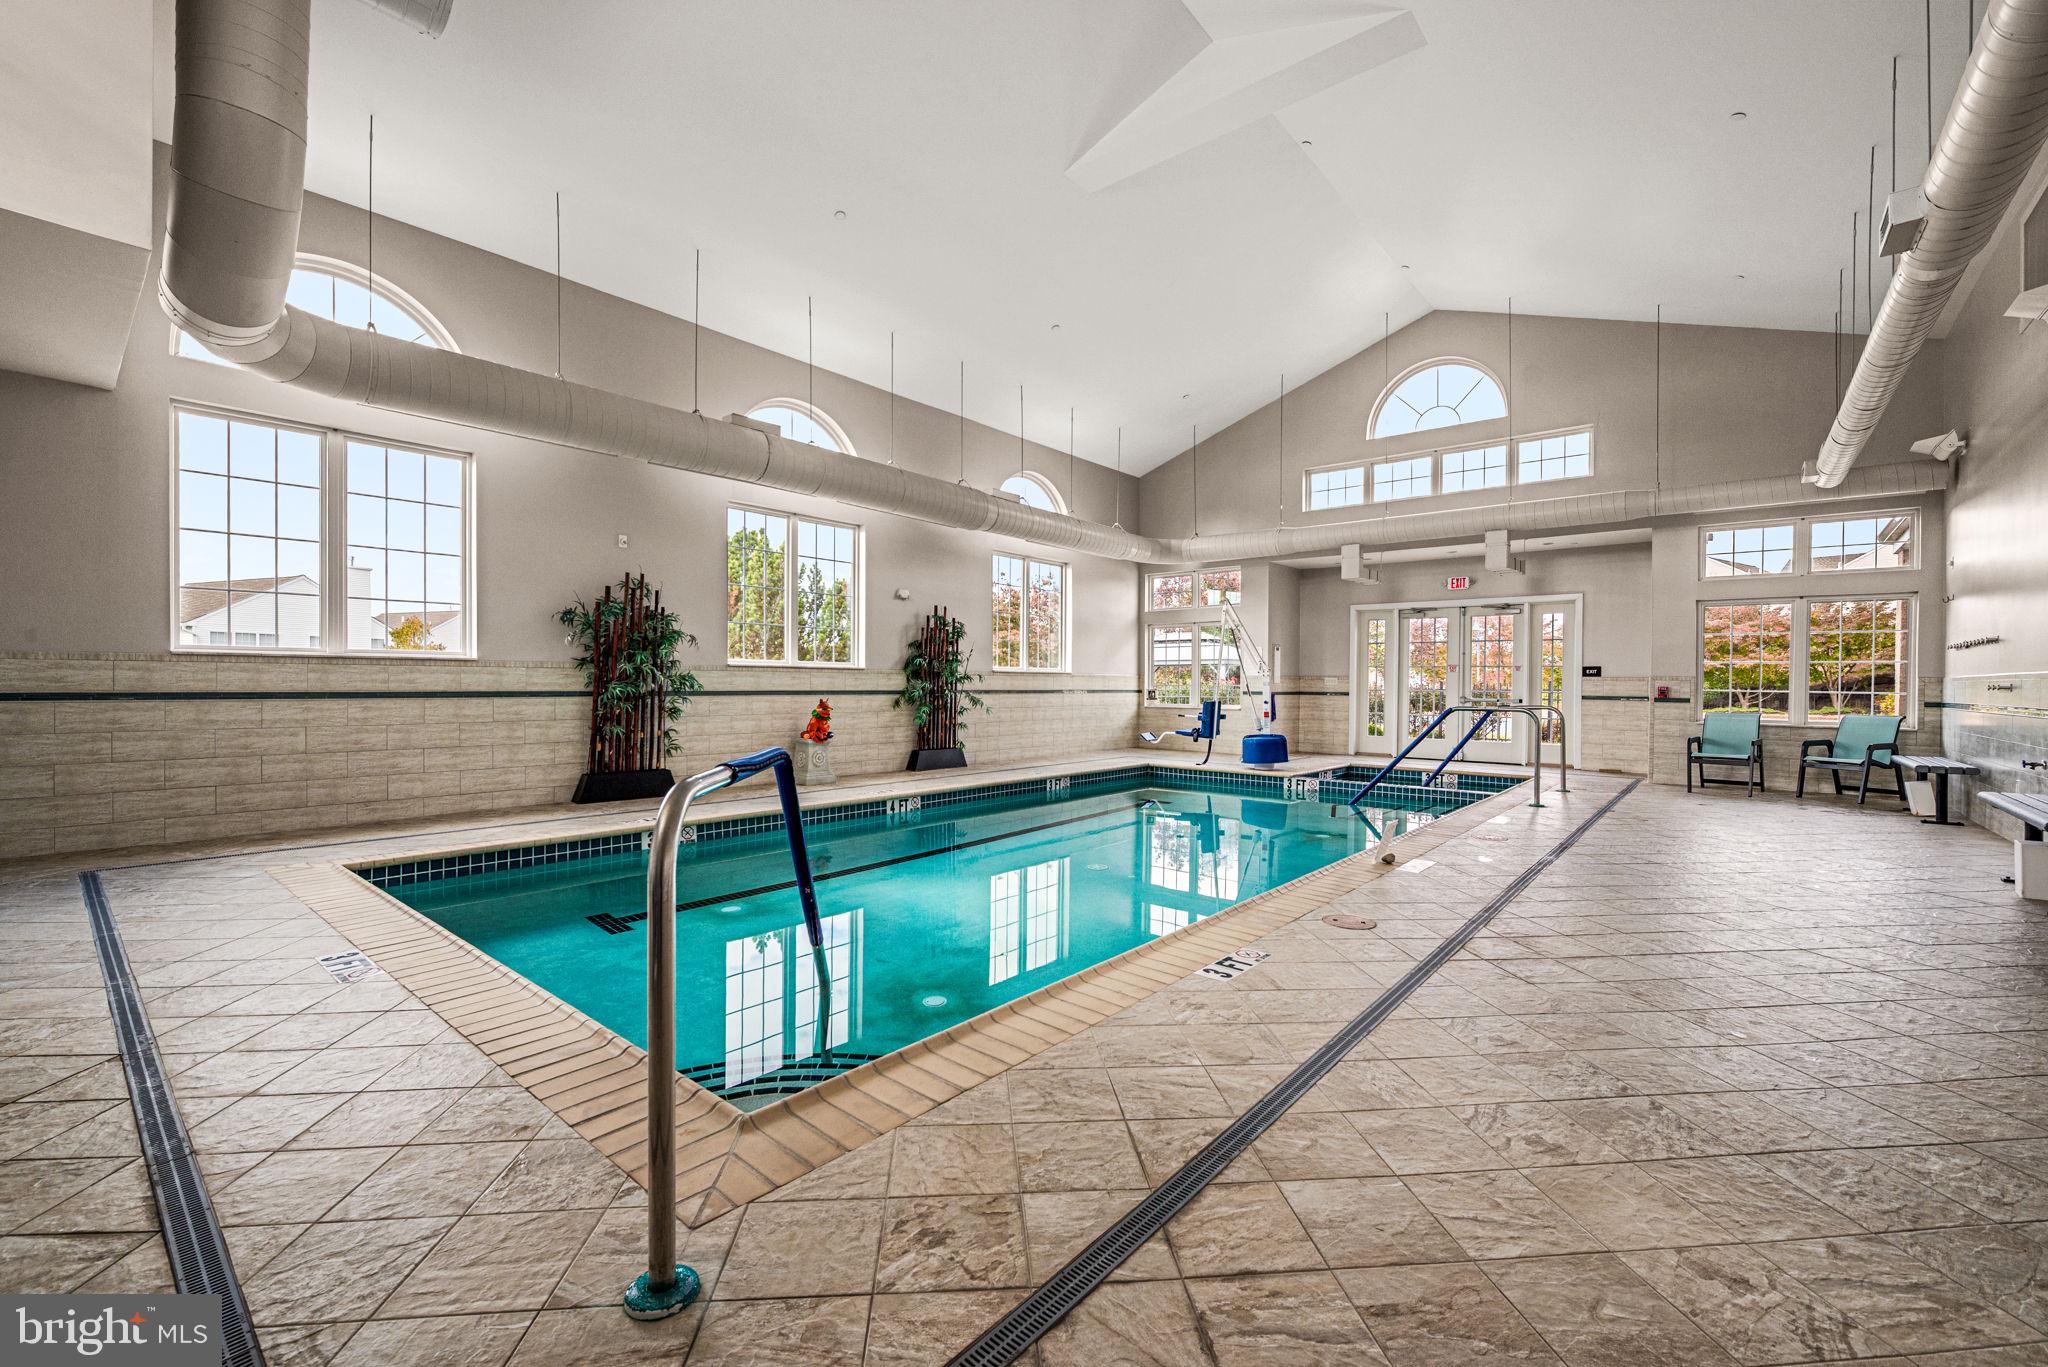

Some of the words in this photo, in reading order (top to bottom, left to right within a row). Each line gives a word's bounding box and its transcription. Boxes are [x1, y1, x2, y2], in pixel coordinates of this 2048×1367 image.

[1451, 577, 1466, 588] EXIT
[1287, 778, 1292, 789] 3
[1296, 779, 1306, 790] FT
[890, 800, 895, 813] 4
[899, 799, 909, 812] FT
[1215, 956, 1253, 972] FT
[1203, 968, 1233, 978] 3
